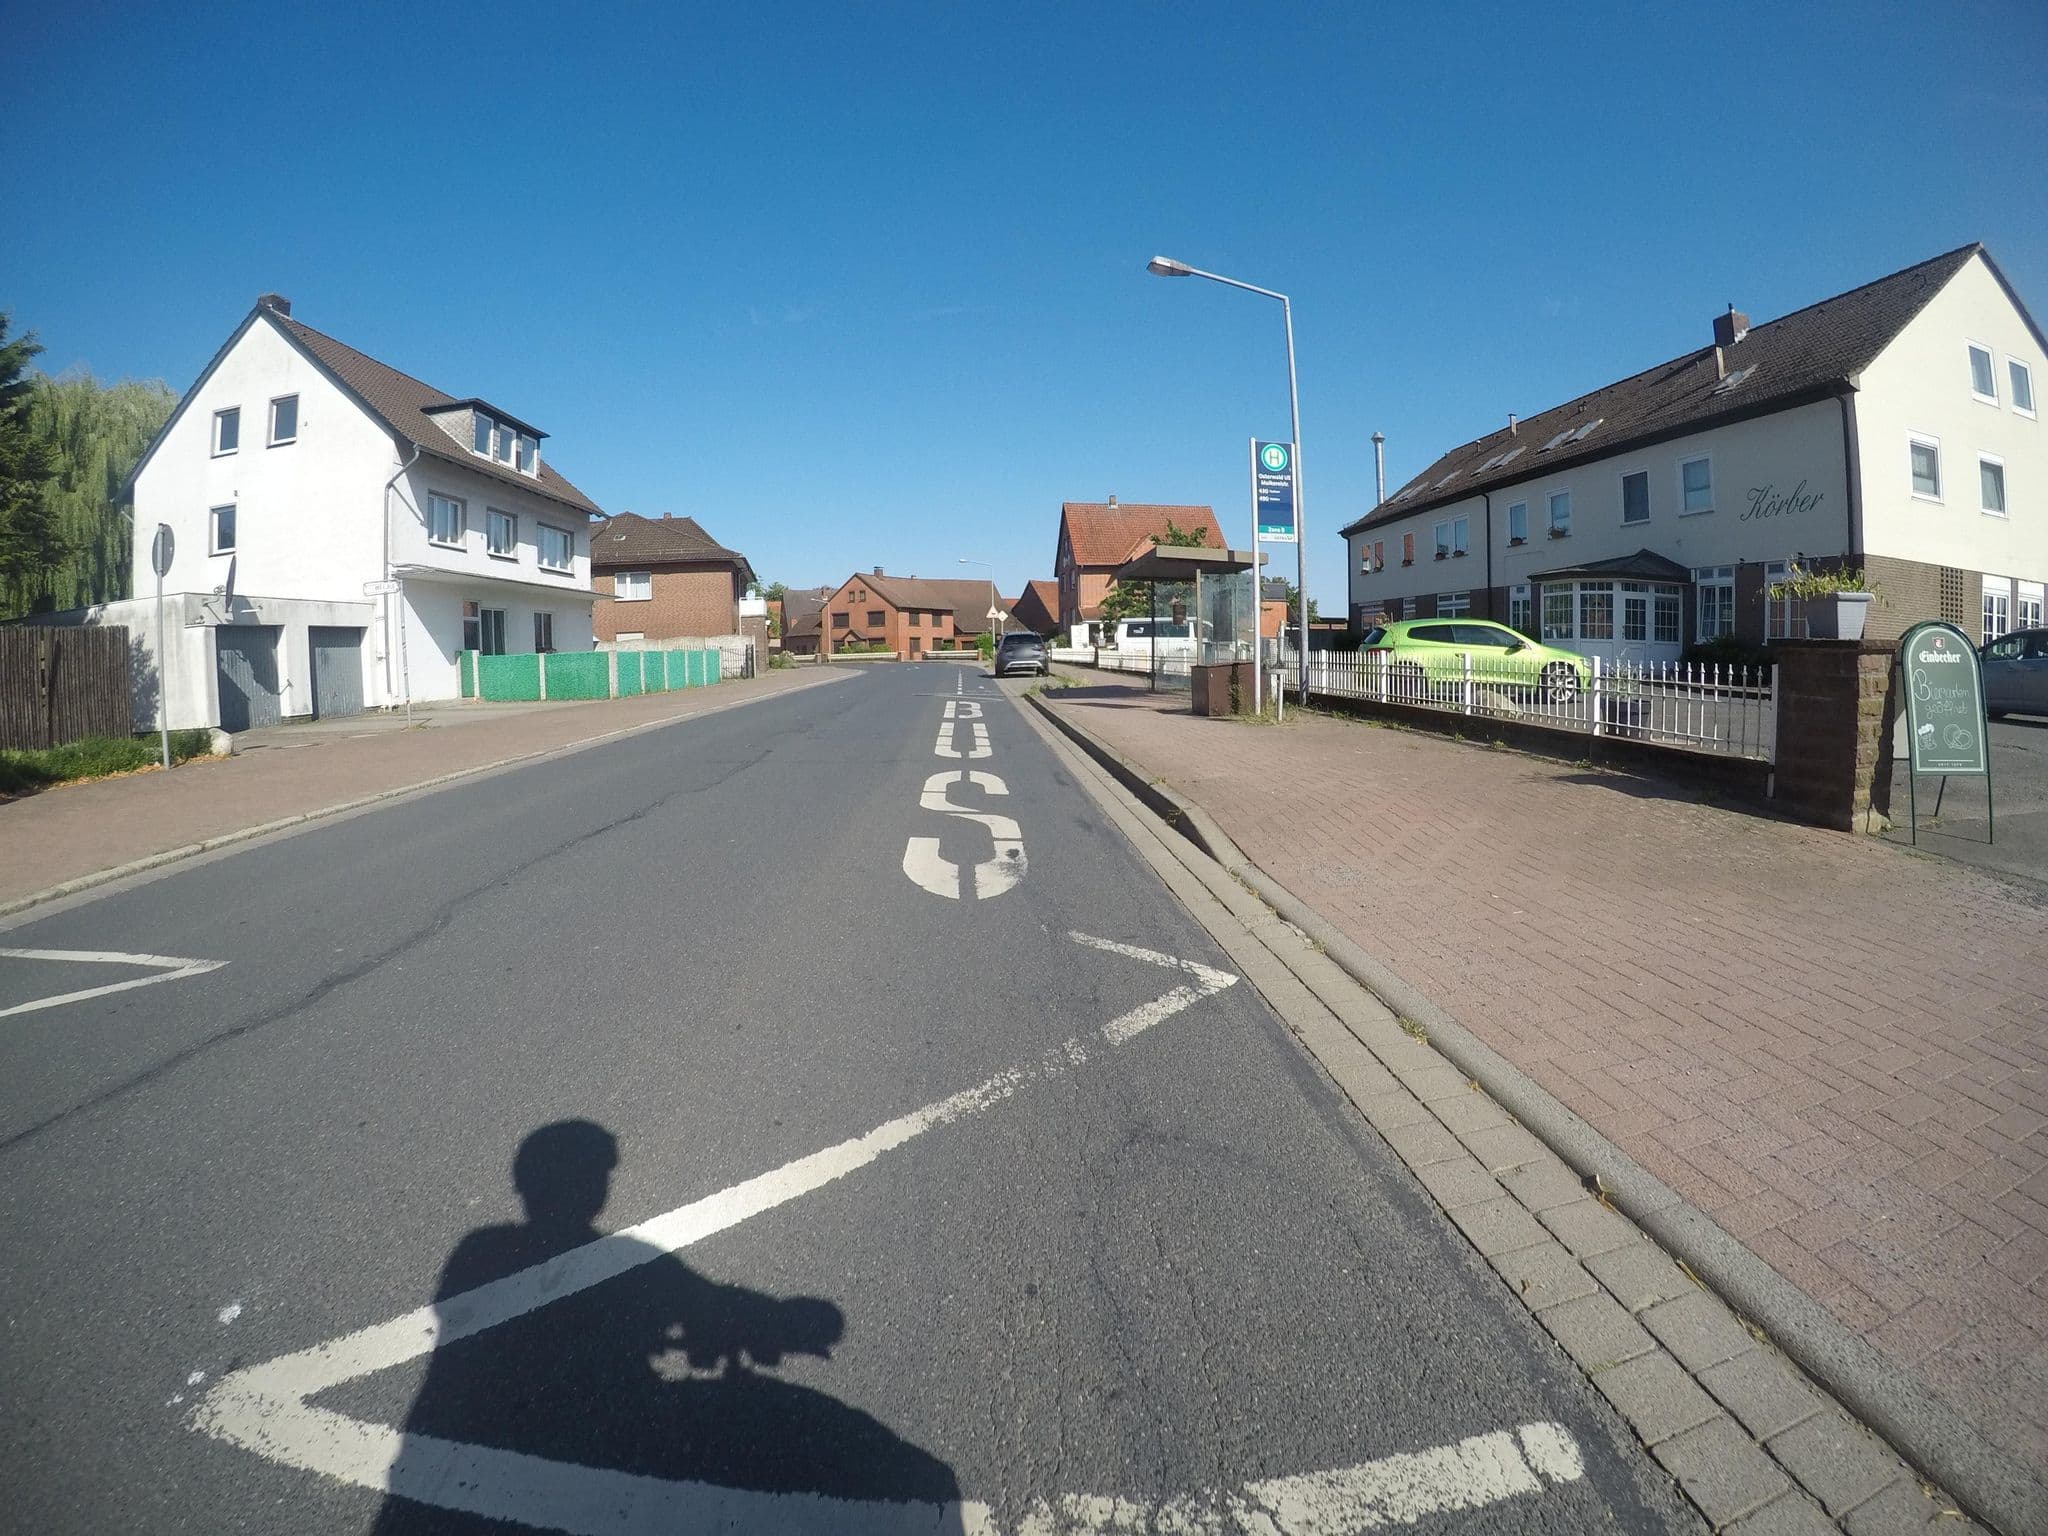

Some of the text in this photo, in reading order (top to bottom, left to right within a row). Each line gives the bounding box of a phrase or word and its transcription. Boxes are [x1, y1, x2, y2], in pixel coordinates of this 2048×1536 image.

[1739, 479, 1824, 522] Körber
[1918, 650, 1961, 663] Einbecker
[902, 700, 1029, 900] BUS
